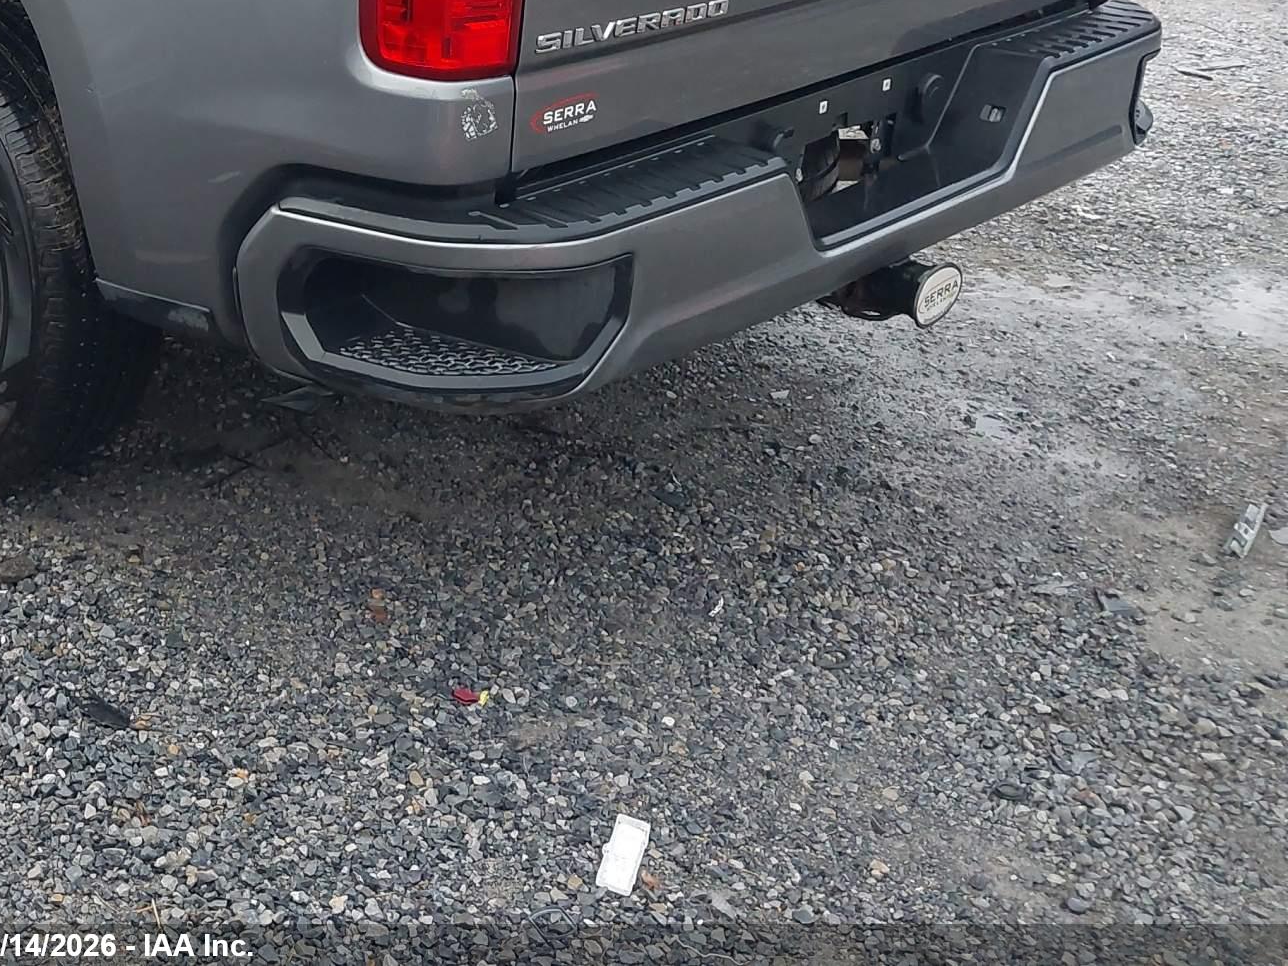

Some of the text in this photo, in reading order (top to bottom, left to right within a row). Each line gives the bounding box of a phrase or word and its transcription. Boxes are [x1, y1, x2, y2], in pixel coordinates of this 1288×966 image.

[543, 100, 597, 125] SERRA
[547, 120, 578, 132] WHELAN
[924, 280, 958, 307] SERRA
